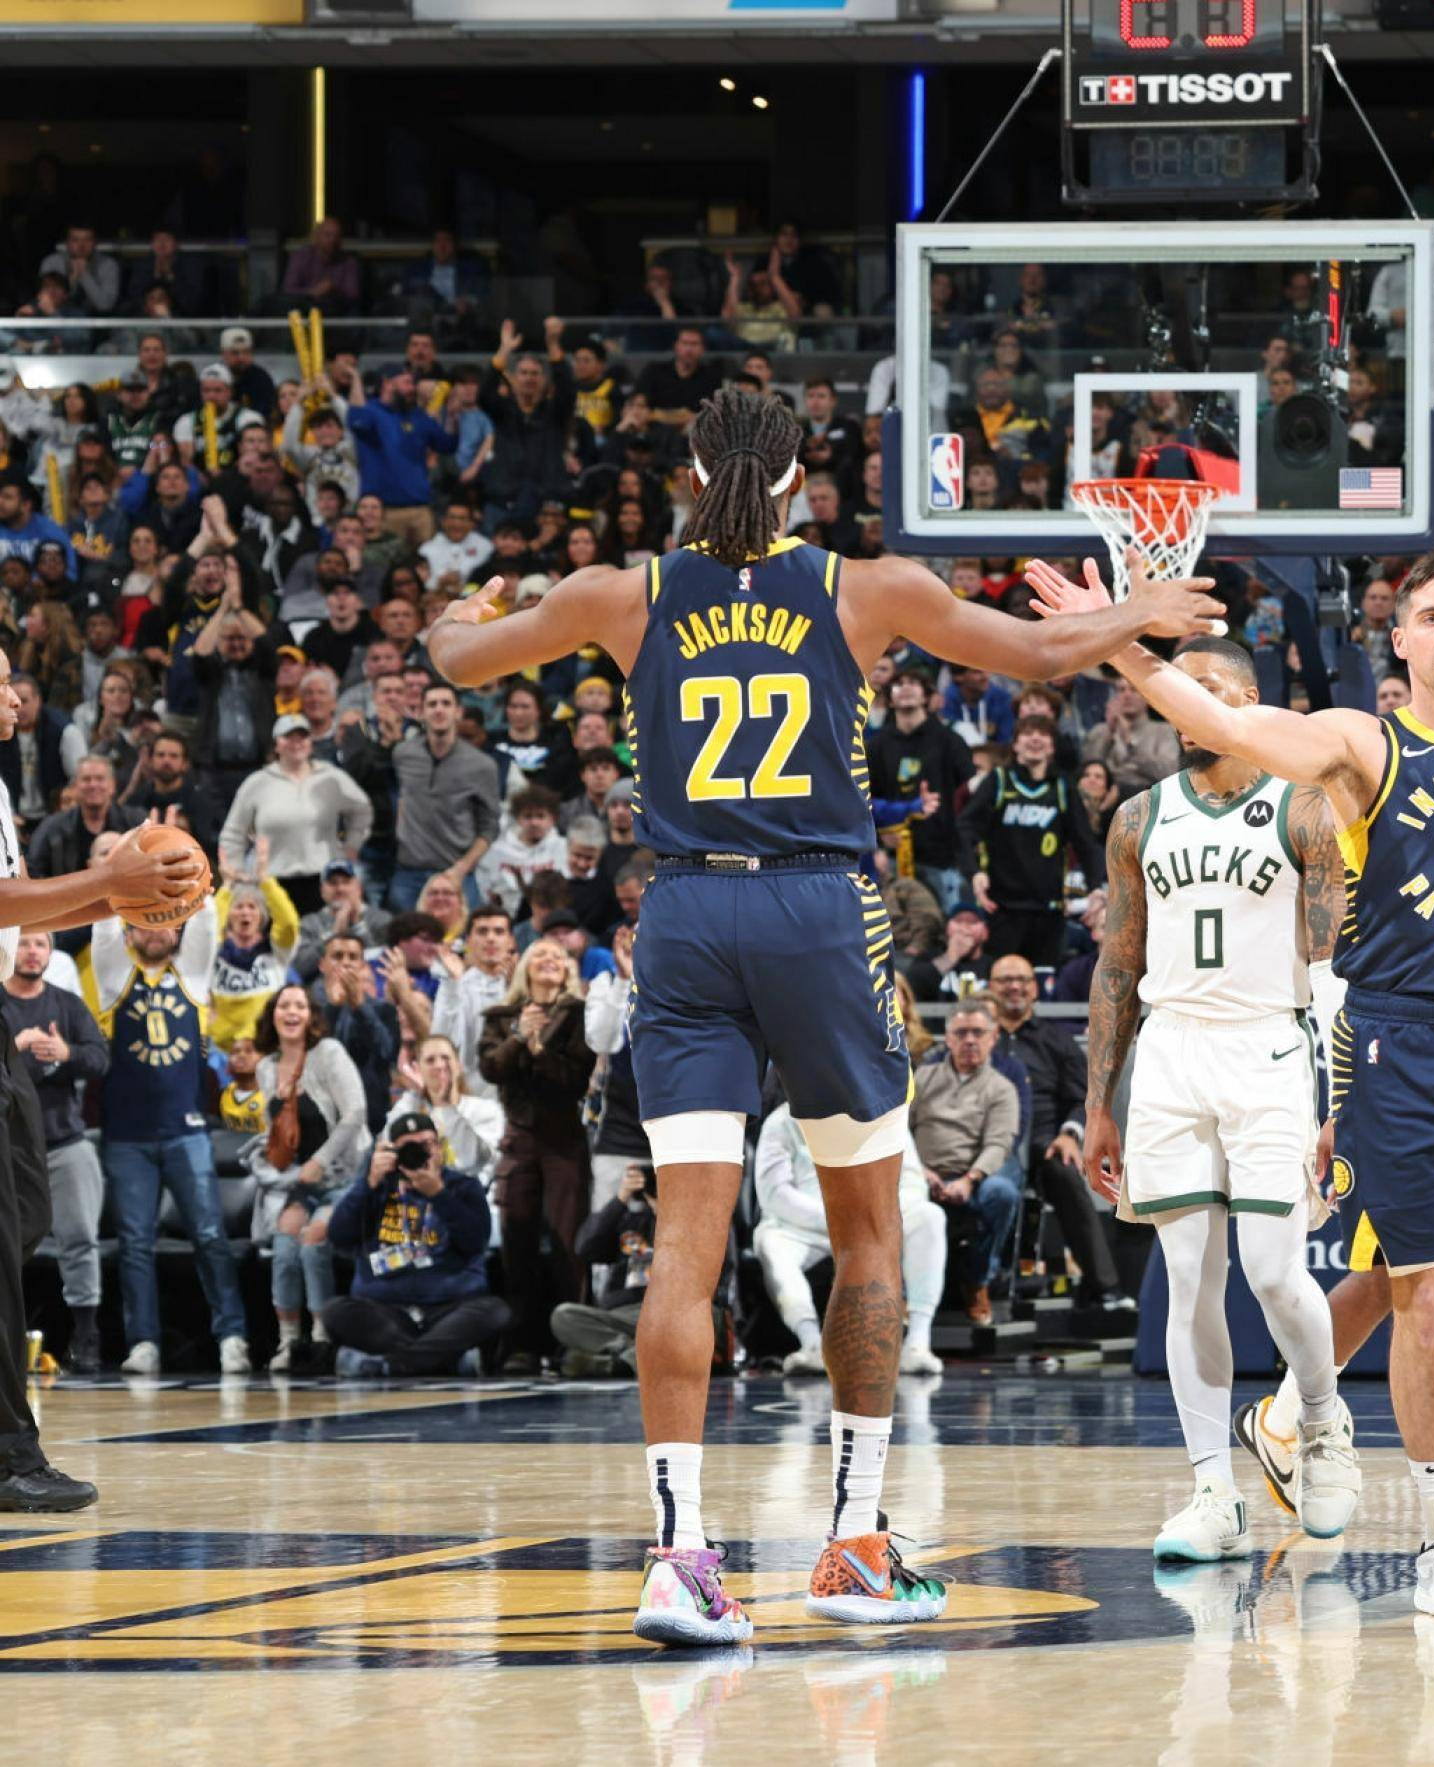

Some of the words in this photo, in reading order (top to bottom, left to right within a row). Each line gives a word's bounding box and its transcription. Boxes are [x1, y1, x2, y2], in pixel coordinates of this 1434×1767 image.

[1138, 72, 1292, 104] TISSOT
[673, 602, 813, 660] JACKSON
[680, 673, 813, 802] 22
[1041, 832, 1057, 857] 0
[1146, 845, 1283, 899] BUCKS
[1194, 908, 1224, 969] 0
[146, 1009, 169, 1046] 0
